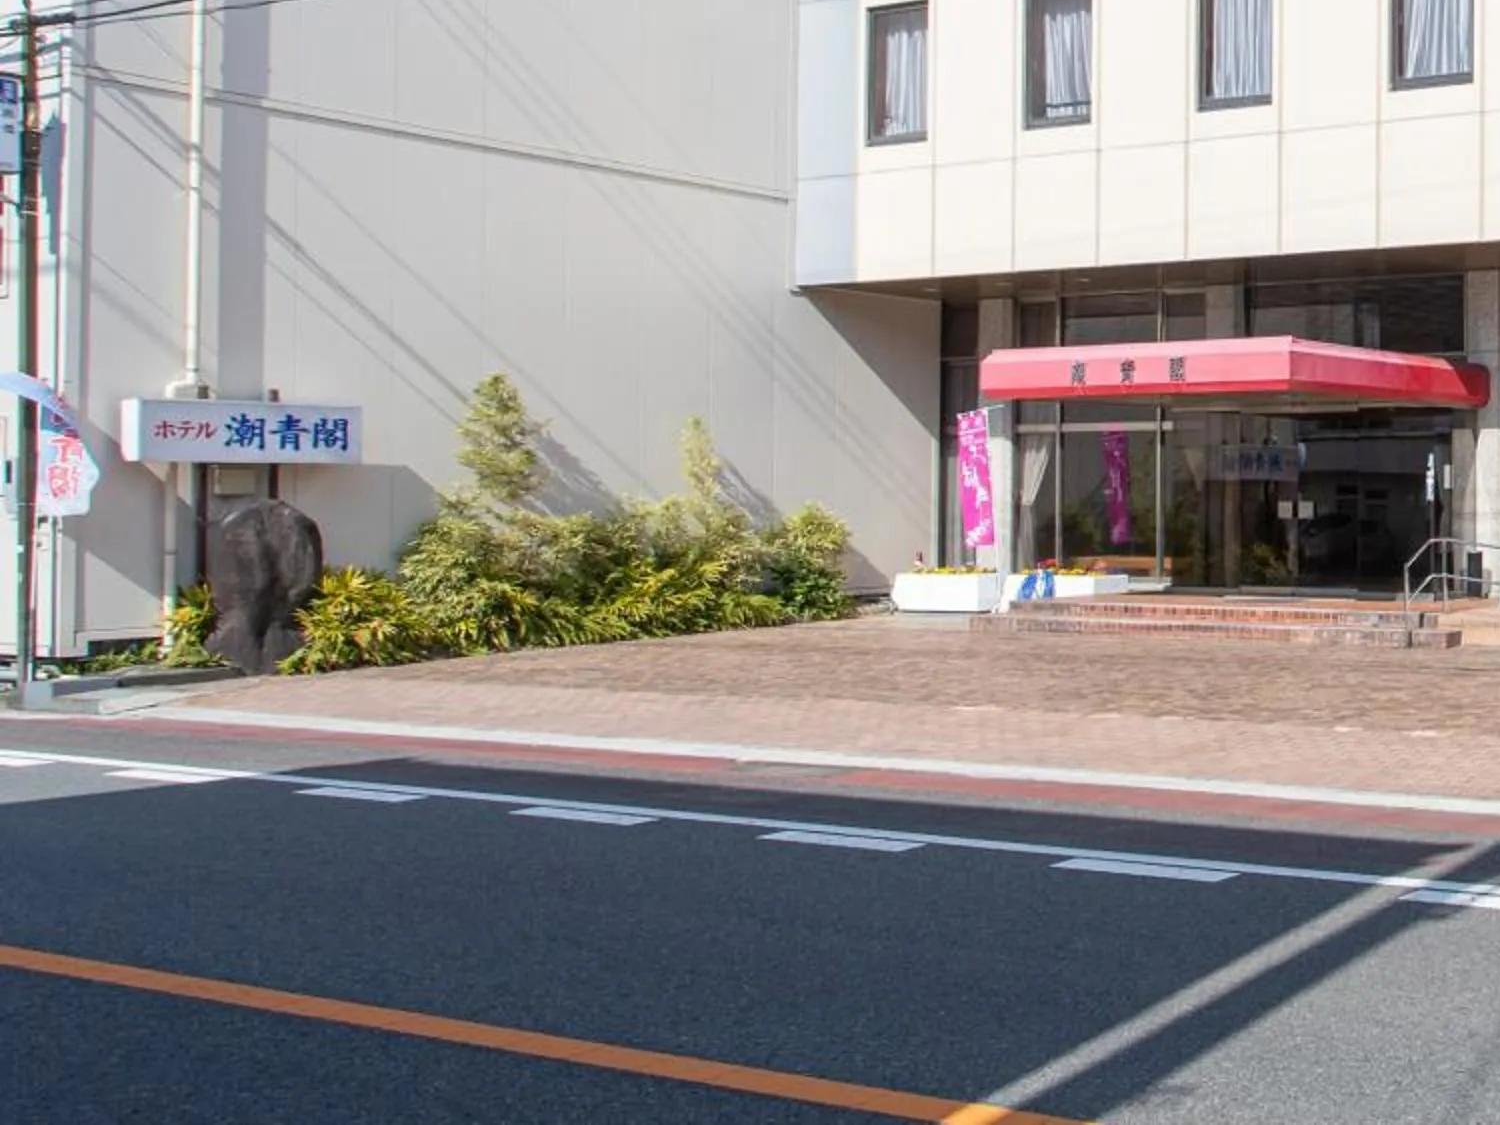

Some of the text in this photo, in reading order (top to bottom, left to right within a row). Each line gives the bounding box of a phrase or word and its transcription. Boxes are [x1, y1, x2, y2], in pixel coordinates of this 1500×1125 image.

[154, 413, 349, 452] ホテル 潮青閣
